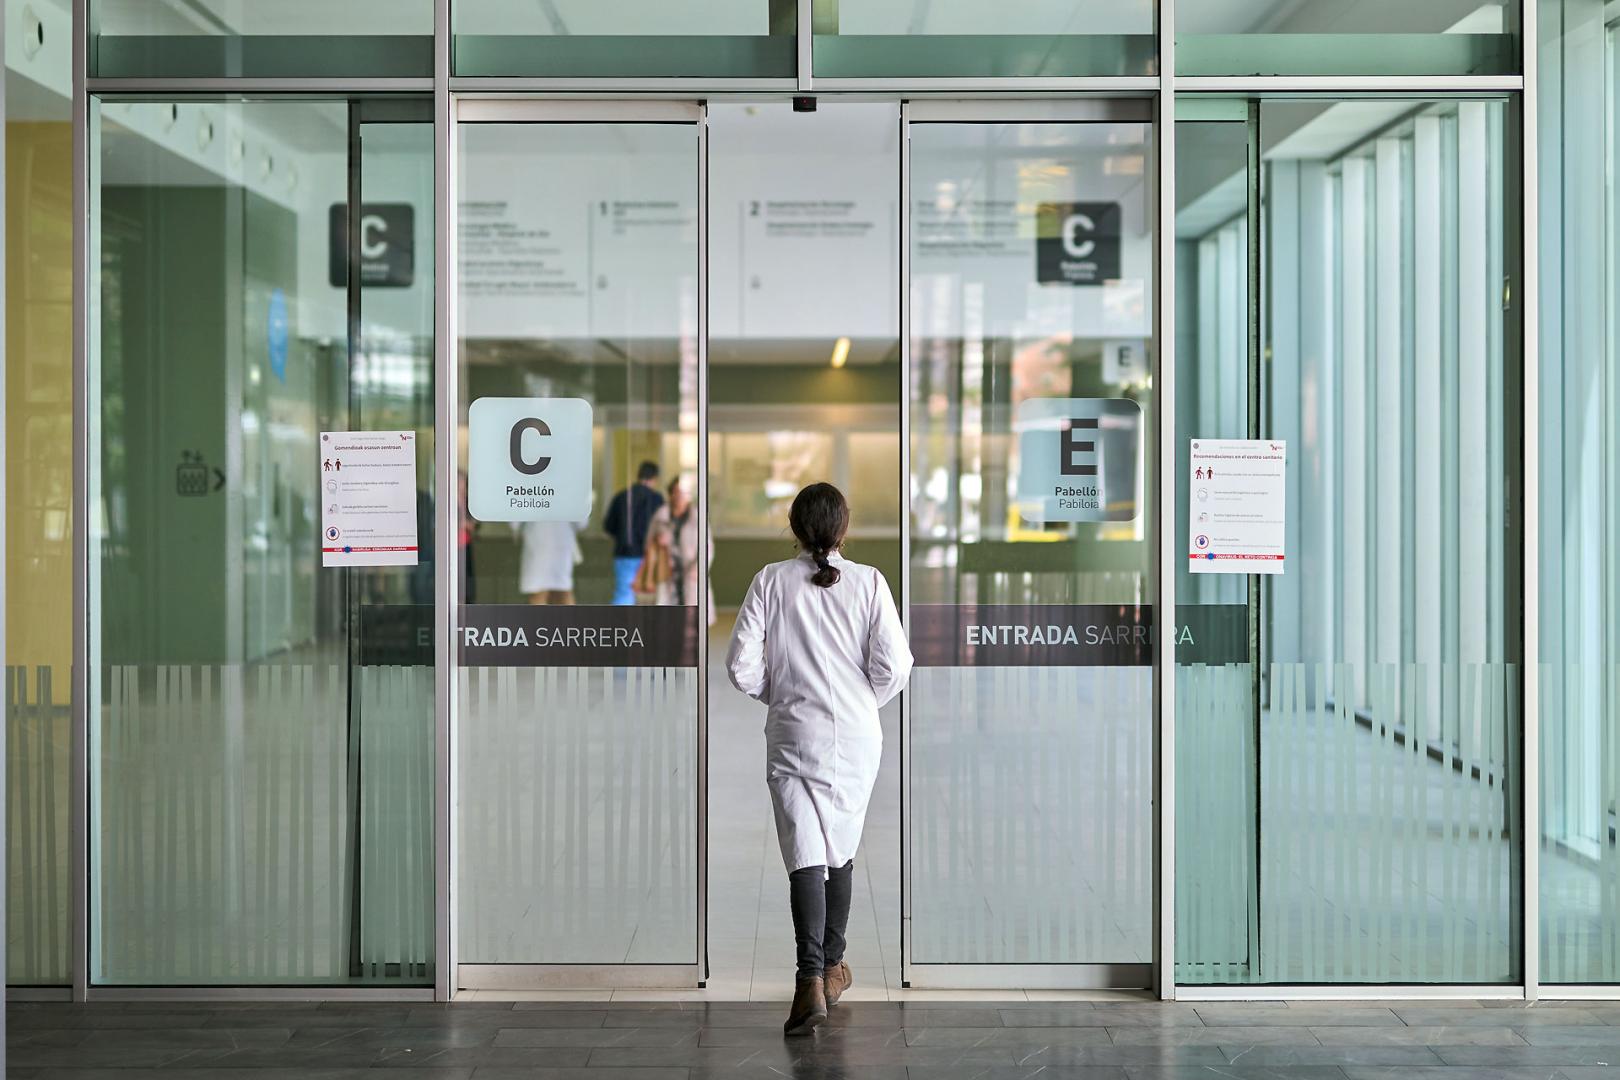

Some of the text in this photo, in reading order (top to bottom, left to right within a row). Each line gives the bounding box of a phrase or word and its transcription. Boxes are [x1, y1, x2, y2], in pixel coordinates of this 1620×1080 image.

[750, 200, 761, 218] 2
[361, 214, 387, 259] C
[1063, 214, 1096, 258] C
[1117, 346, 1132, 367] E
[510, 417, 552, 475] C
[1060, 418, 1099, 476] E
[506, 486, 555, 496] Pabellón
[510, 498, 550, 508] Pabiloia
[1059, 498, 1100, 509] Pabiloia
[536, 627, 644, 647] SARRERA
[966, 625, 1079, 645] ENTRADA
